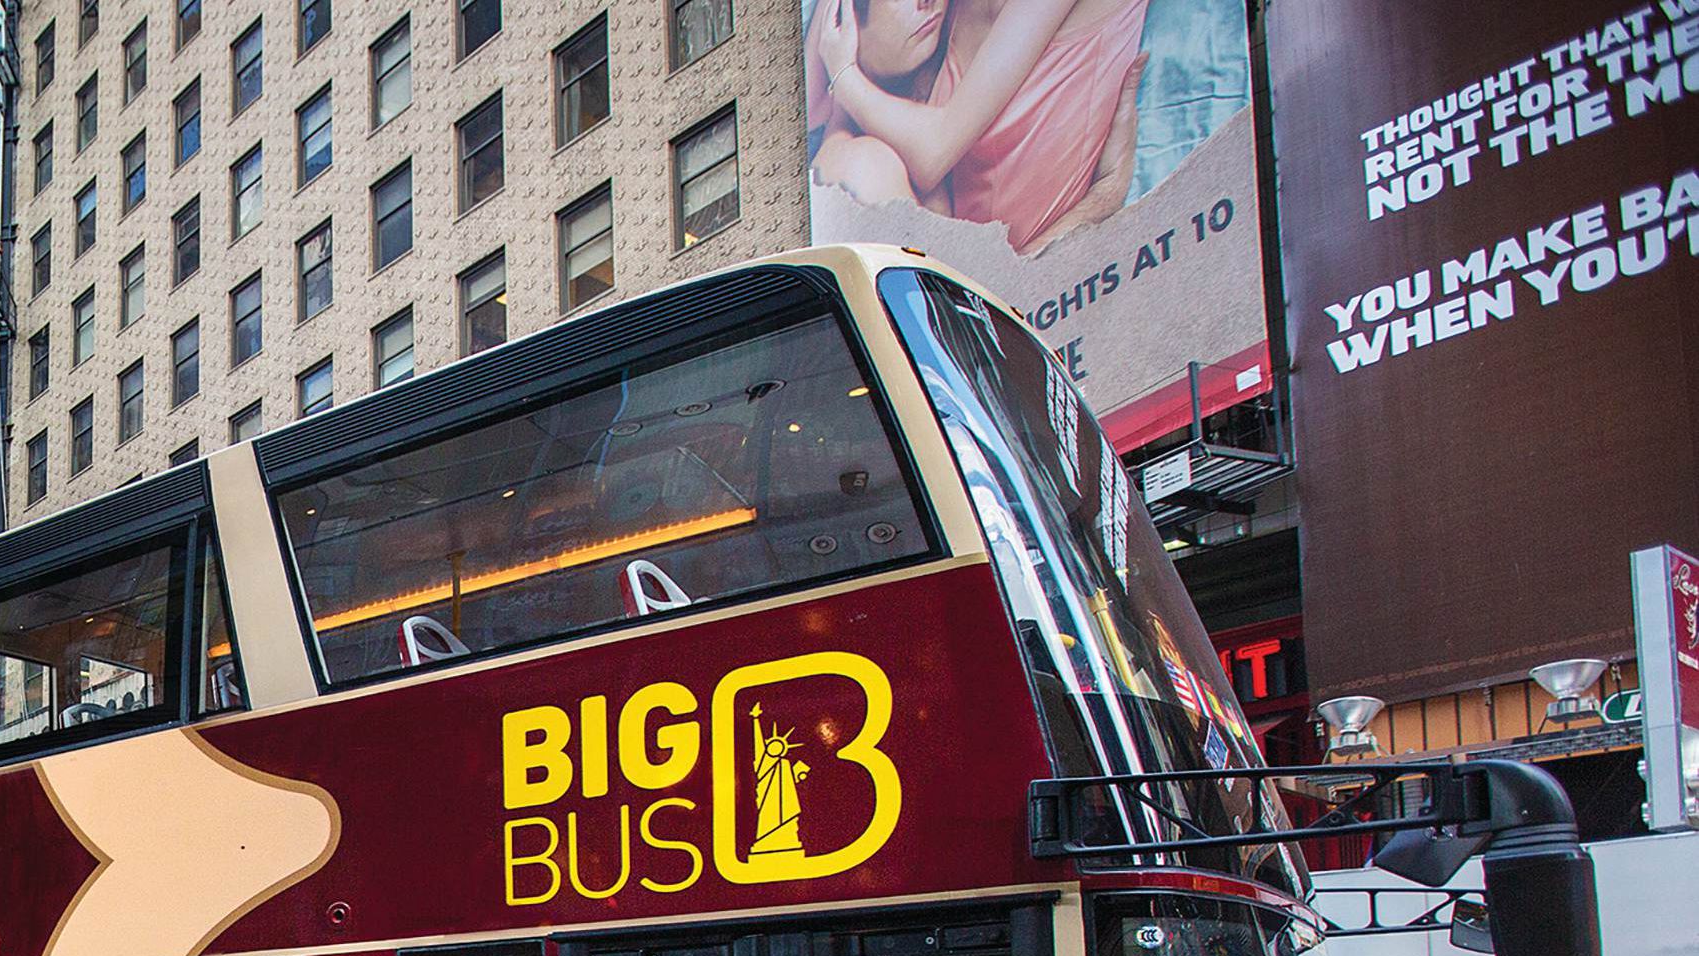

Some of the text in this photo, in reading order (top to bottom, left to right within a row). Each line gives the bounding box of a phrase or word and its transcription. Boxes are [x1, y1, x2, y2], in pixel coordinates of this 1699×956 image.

[1360, 58, 1536, 152] THOUGHT
[1542, 7, 1652, 72] THAT
[1364, 109, 1484, 185] RENT
[1491, 68, 1589, 131] FOR
[1367, 145, 1480, 222] NOT
[1488, 90, 1613, 167] THE
[1131, 228, 1175, 280] AT
[1191, 198, 1234, 243] 10
[1324, 270, 1430, 333] YOU
[1441, 205, 1608, 296] MAKE
[1326, 280, 1514, 374] WHEN
[502, 682, 700, 809] BIG
[504, 797, 703, 906] BUS
